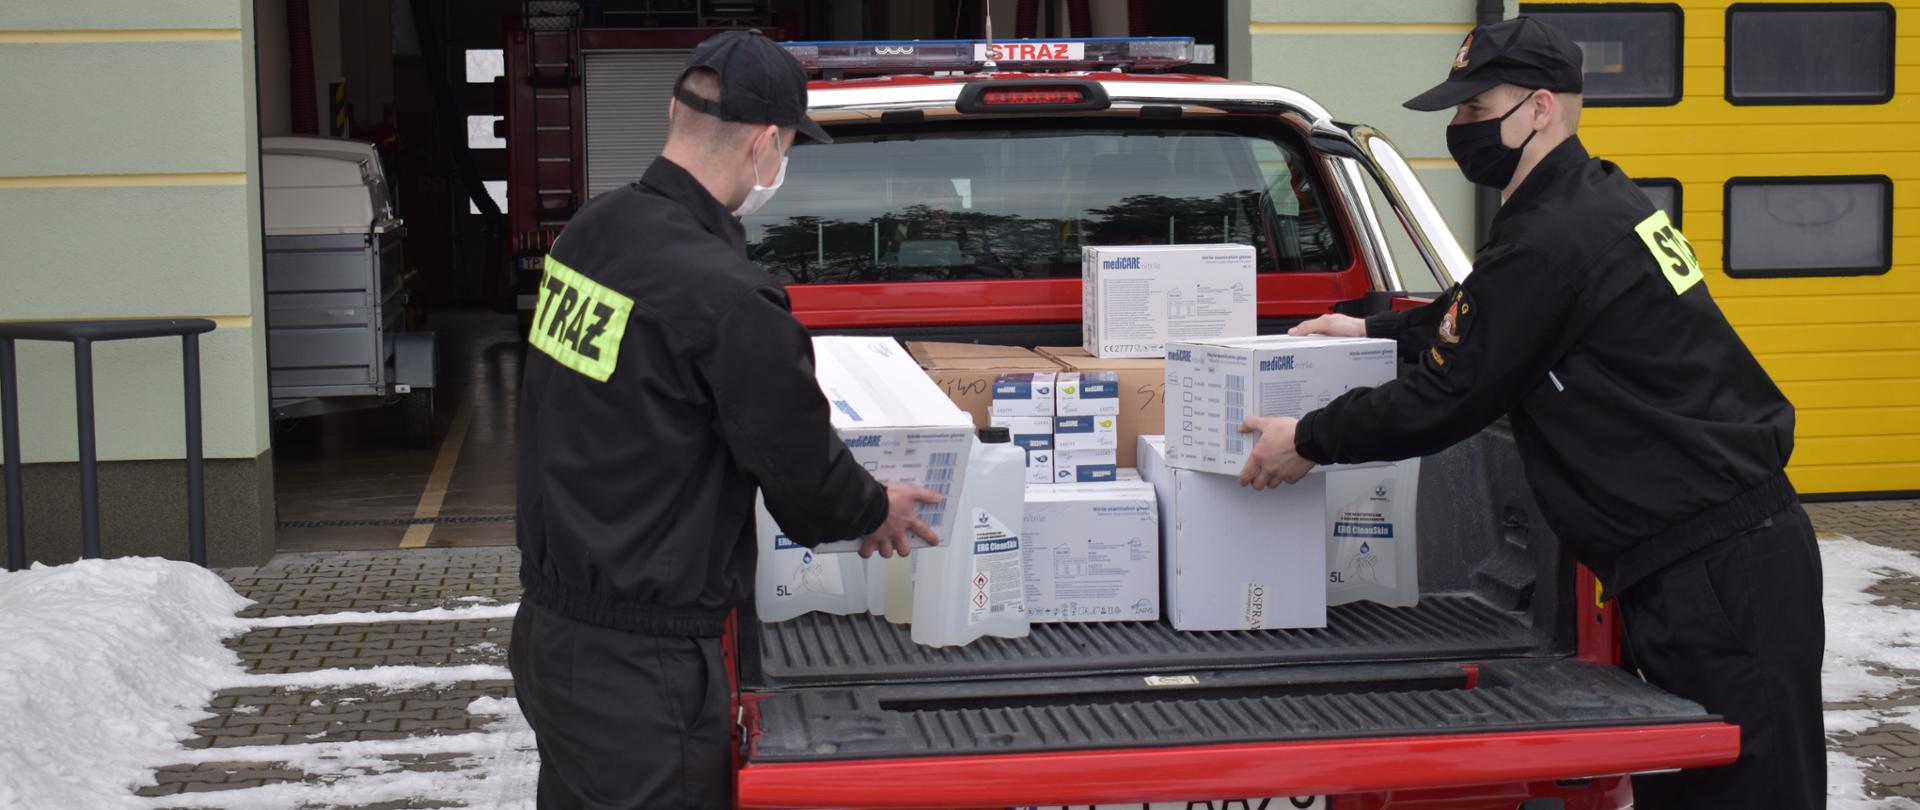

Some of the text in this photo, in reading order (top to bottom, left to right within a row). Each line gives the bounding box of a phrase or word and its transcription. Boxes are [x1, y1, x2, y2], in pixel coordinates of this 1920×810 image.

[991, 43, 1068, 60] STRAŻ
[1103, 257, 1141, 270] mediCARE
[537, 270, 615, 361] TRAŻ
[1260, 356, 1295, 371] mediCARE
[1330, 572, 1345, 583] 5L
[776, 585, 792, 597] 5L
